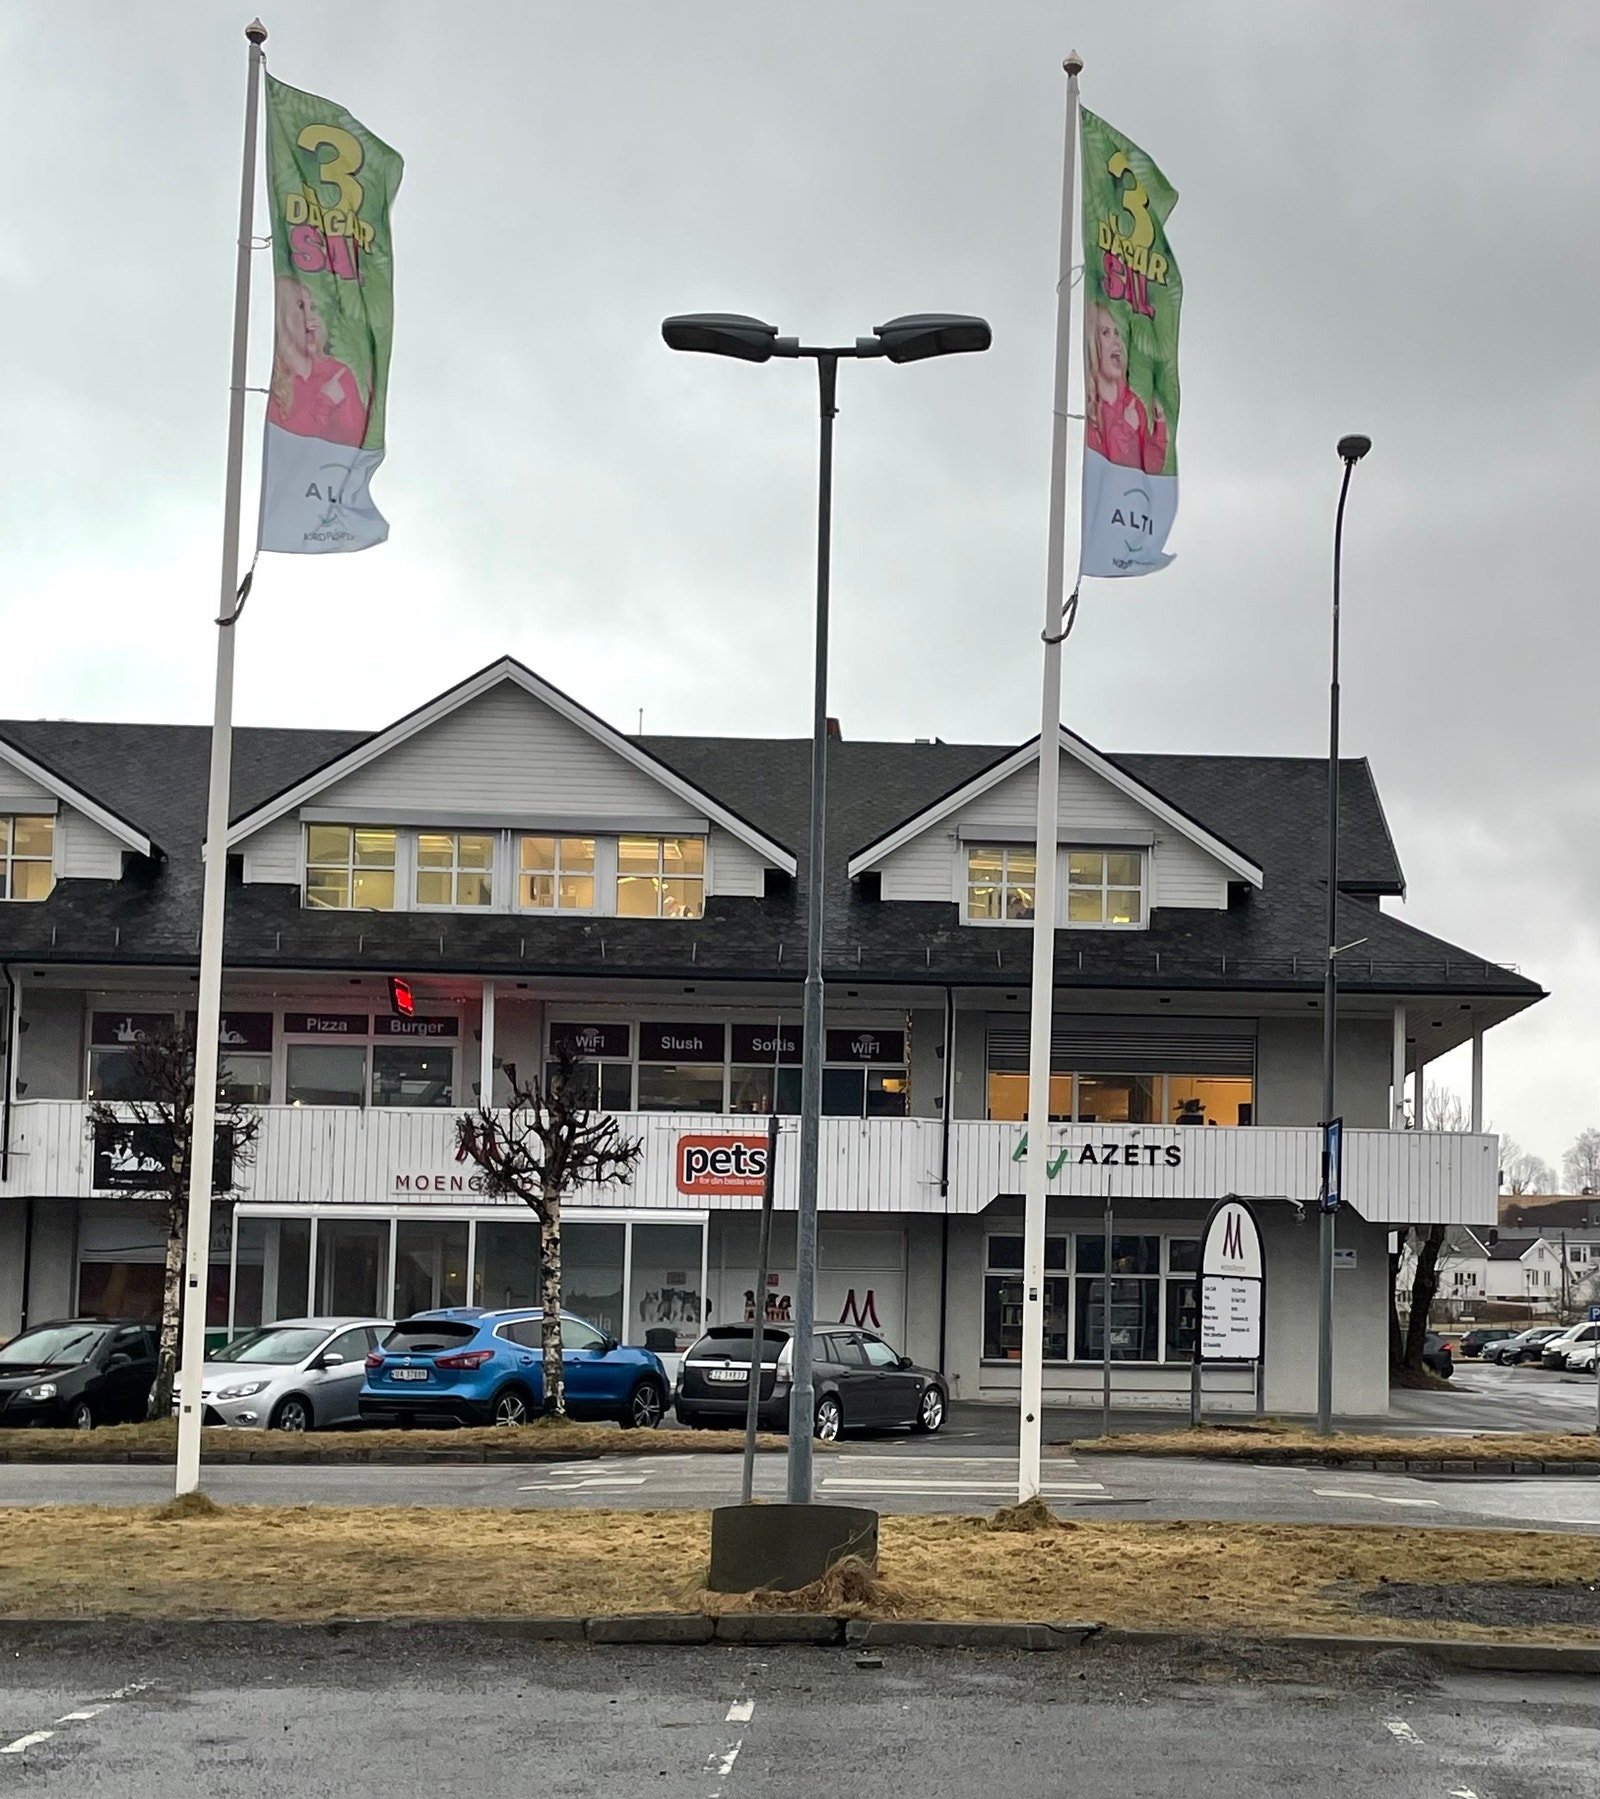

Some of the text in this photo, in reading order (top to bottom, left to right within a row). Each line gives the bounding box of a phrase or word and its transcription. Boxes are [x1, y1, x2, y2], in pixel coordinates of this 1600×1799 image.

[297, 123, 364, 213] 3
[1107, 151, 1155, 250] 3
[1111, 508, 1153, 536] ALTI
[306, 1017, 348, 1032] Pizza
[390, 1019, 445, 1035] Burger
[660, 1036, 703, 1050] Slush
[684, 1143, 768, 1183] pets
[1078, 1143, 1182, 1167] AZETS
[1592, 1307, 1600, 1320] P
